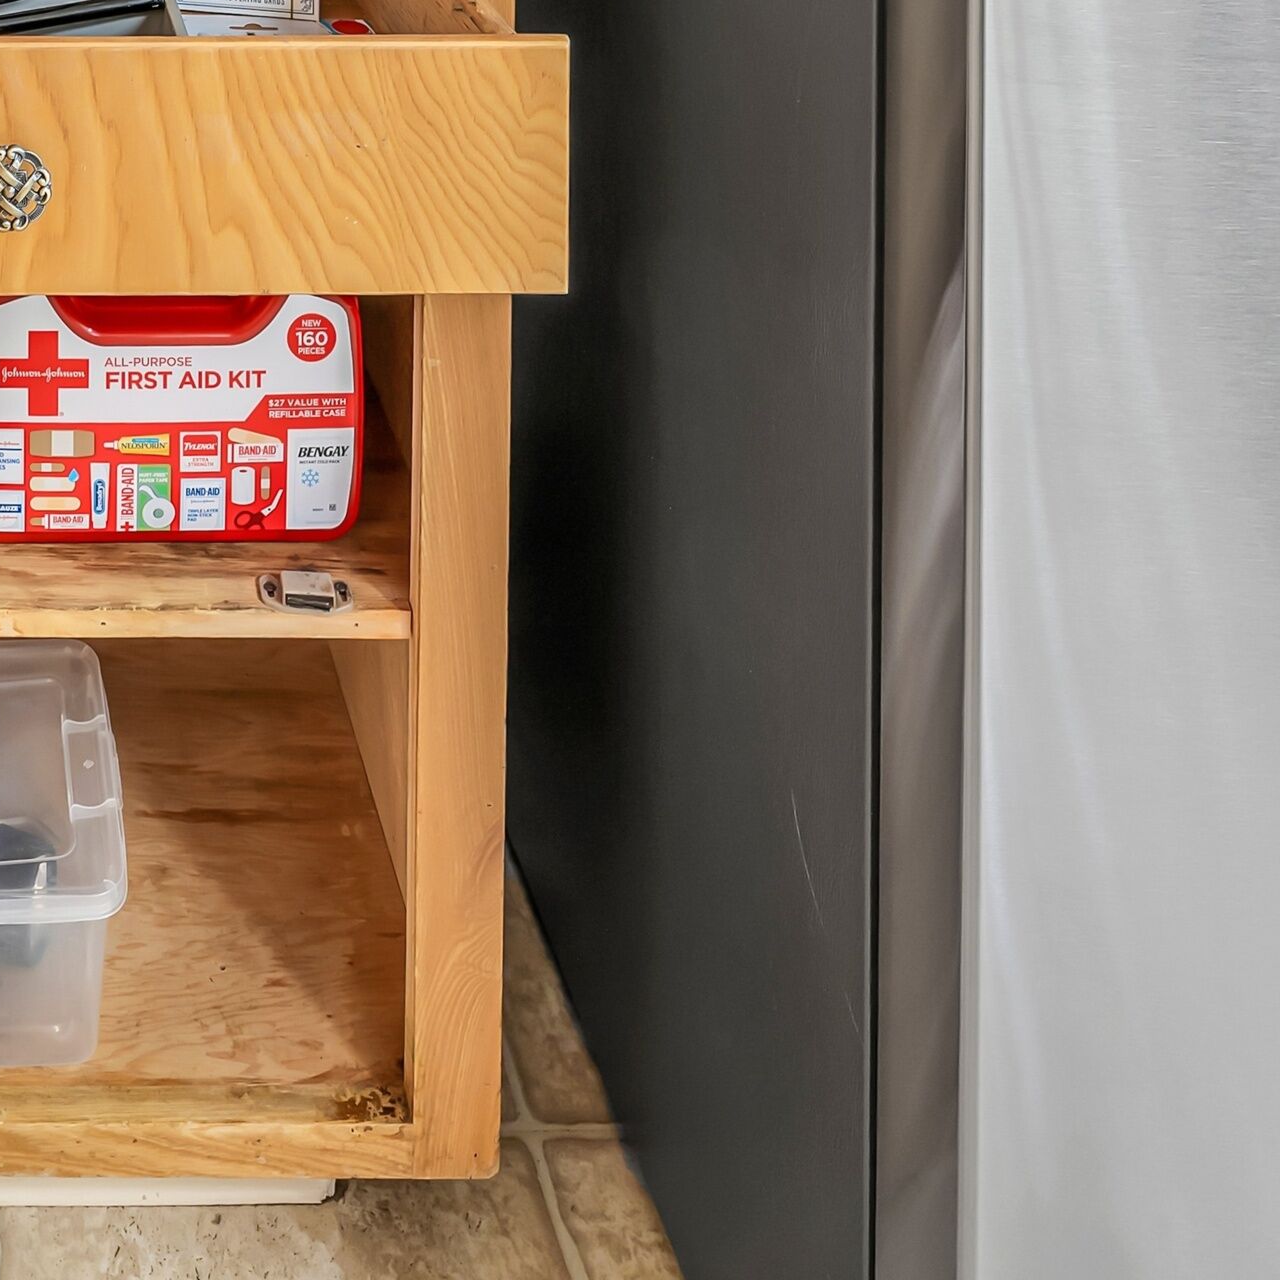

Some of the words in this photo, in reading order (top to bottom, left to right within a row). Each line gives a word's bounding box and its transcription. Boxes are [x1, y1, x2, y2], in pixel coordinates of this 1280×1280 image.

[301, 319, 322, 327] NEW
[295, 331, 328, 346] 160
[298, 347, 325, 355] PIECES
[104, 356, 193, 367] ALL-PURPOSE
[105, 371, 173, 389] FIRST
[179, 371, 222, 389] AID
[228, 370, 267, 389] KIT
[268, 399, 284, 408] $27
[287, 398, 319, 407] VALUE
[321, 398, 347, 406] WITH
[268, 409, 321, 419] REFILLABLE
[322, 409, 346, 417] CASE
[297, 445, 350, 458] BENGAY
